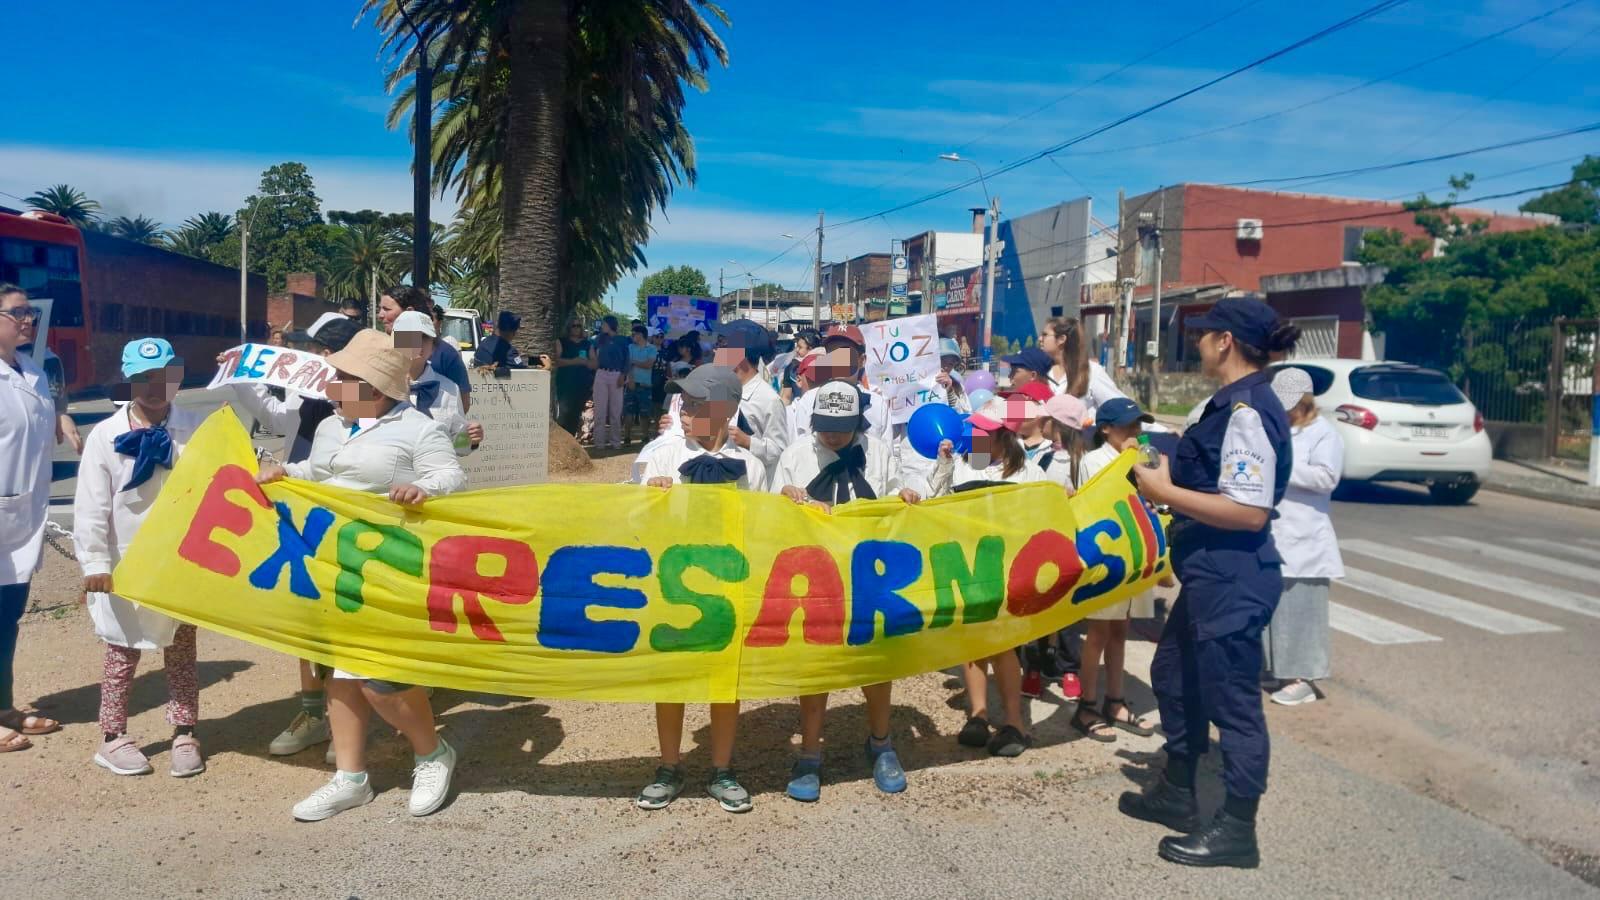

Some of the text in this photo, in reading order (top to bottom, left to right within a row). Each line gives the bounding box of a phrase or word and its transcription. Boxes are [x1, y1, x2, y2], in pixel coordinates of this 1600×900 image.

[875, 324, 899, 339] TU
[872, 335, 934, 365] VOZ
[1223, 449, 1265, 464] CANELONES
